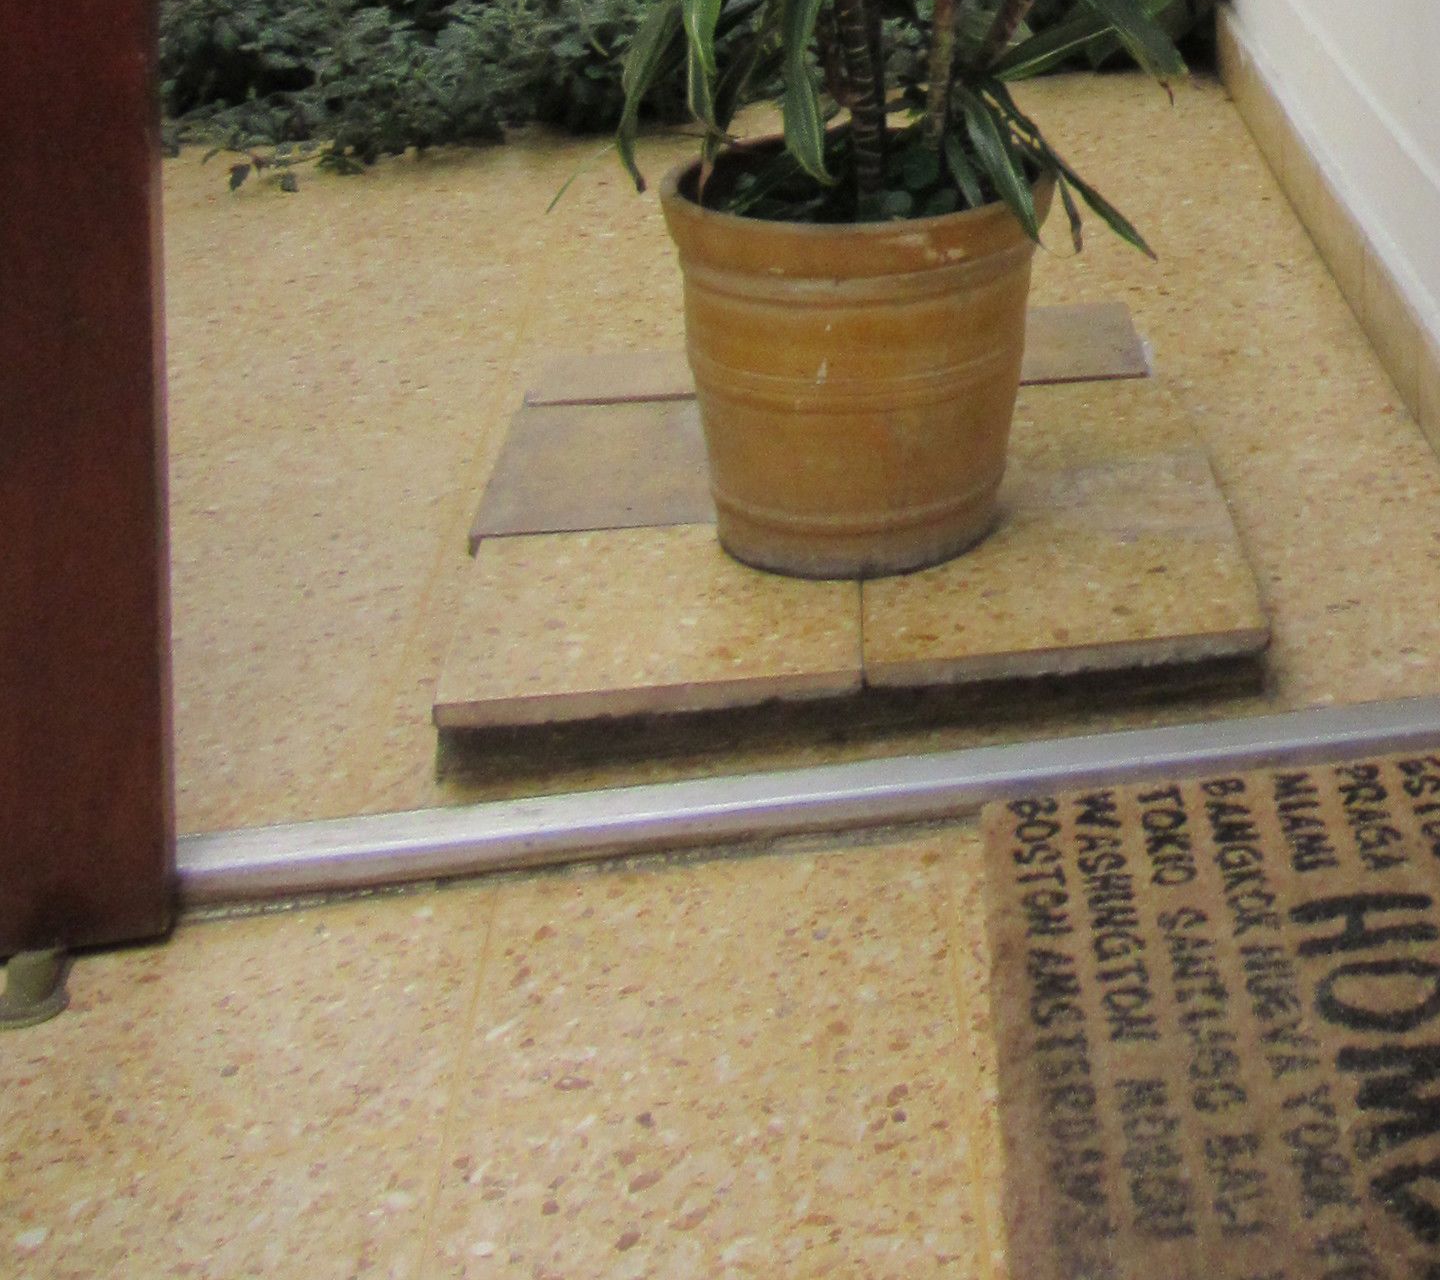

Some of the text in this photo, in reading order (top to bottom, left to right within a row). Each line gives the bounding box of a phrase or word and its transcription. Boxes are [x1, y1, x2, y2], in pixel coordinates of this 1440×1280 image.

[1006, 795, 1073, 937] BOSTON
[1136, 784, 1197, 886] TOKIO
[1200, 778, 1279, 935] BANGKOK
[1273, 772, 1339, 872] MIAMI
[1333, 764, 1408, 871] PRAGA
[1073, 791, 1158, 1040] WASHINGTON
